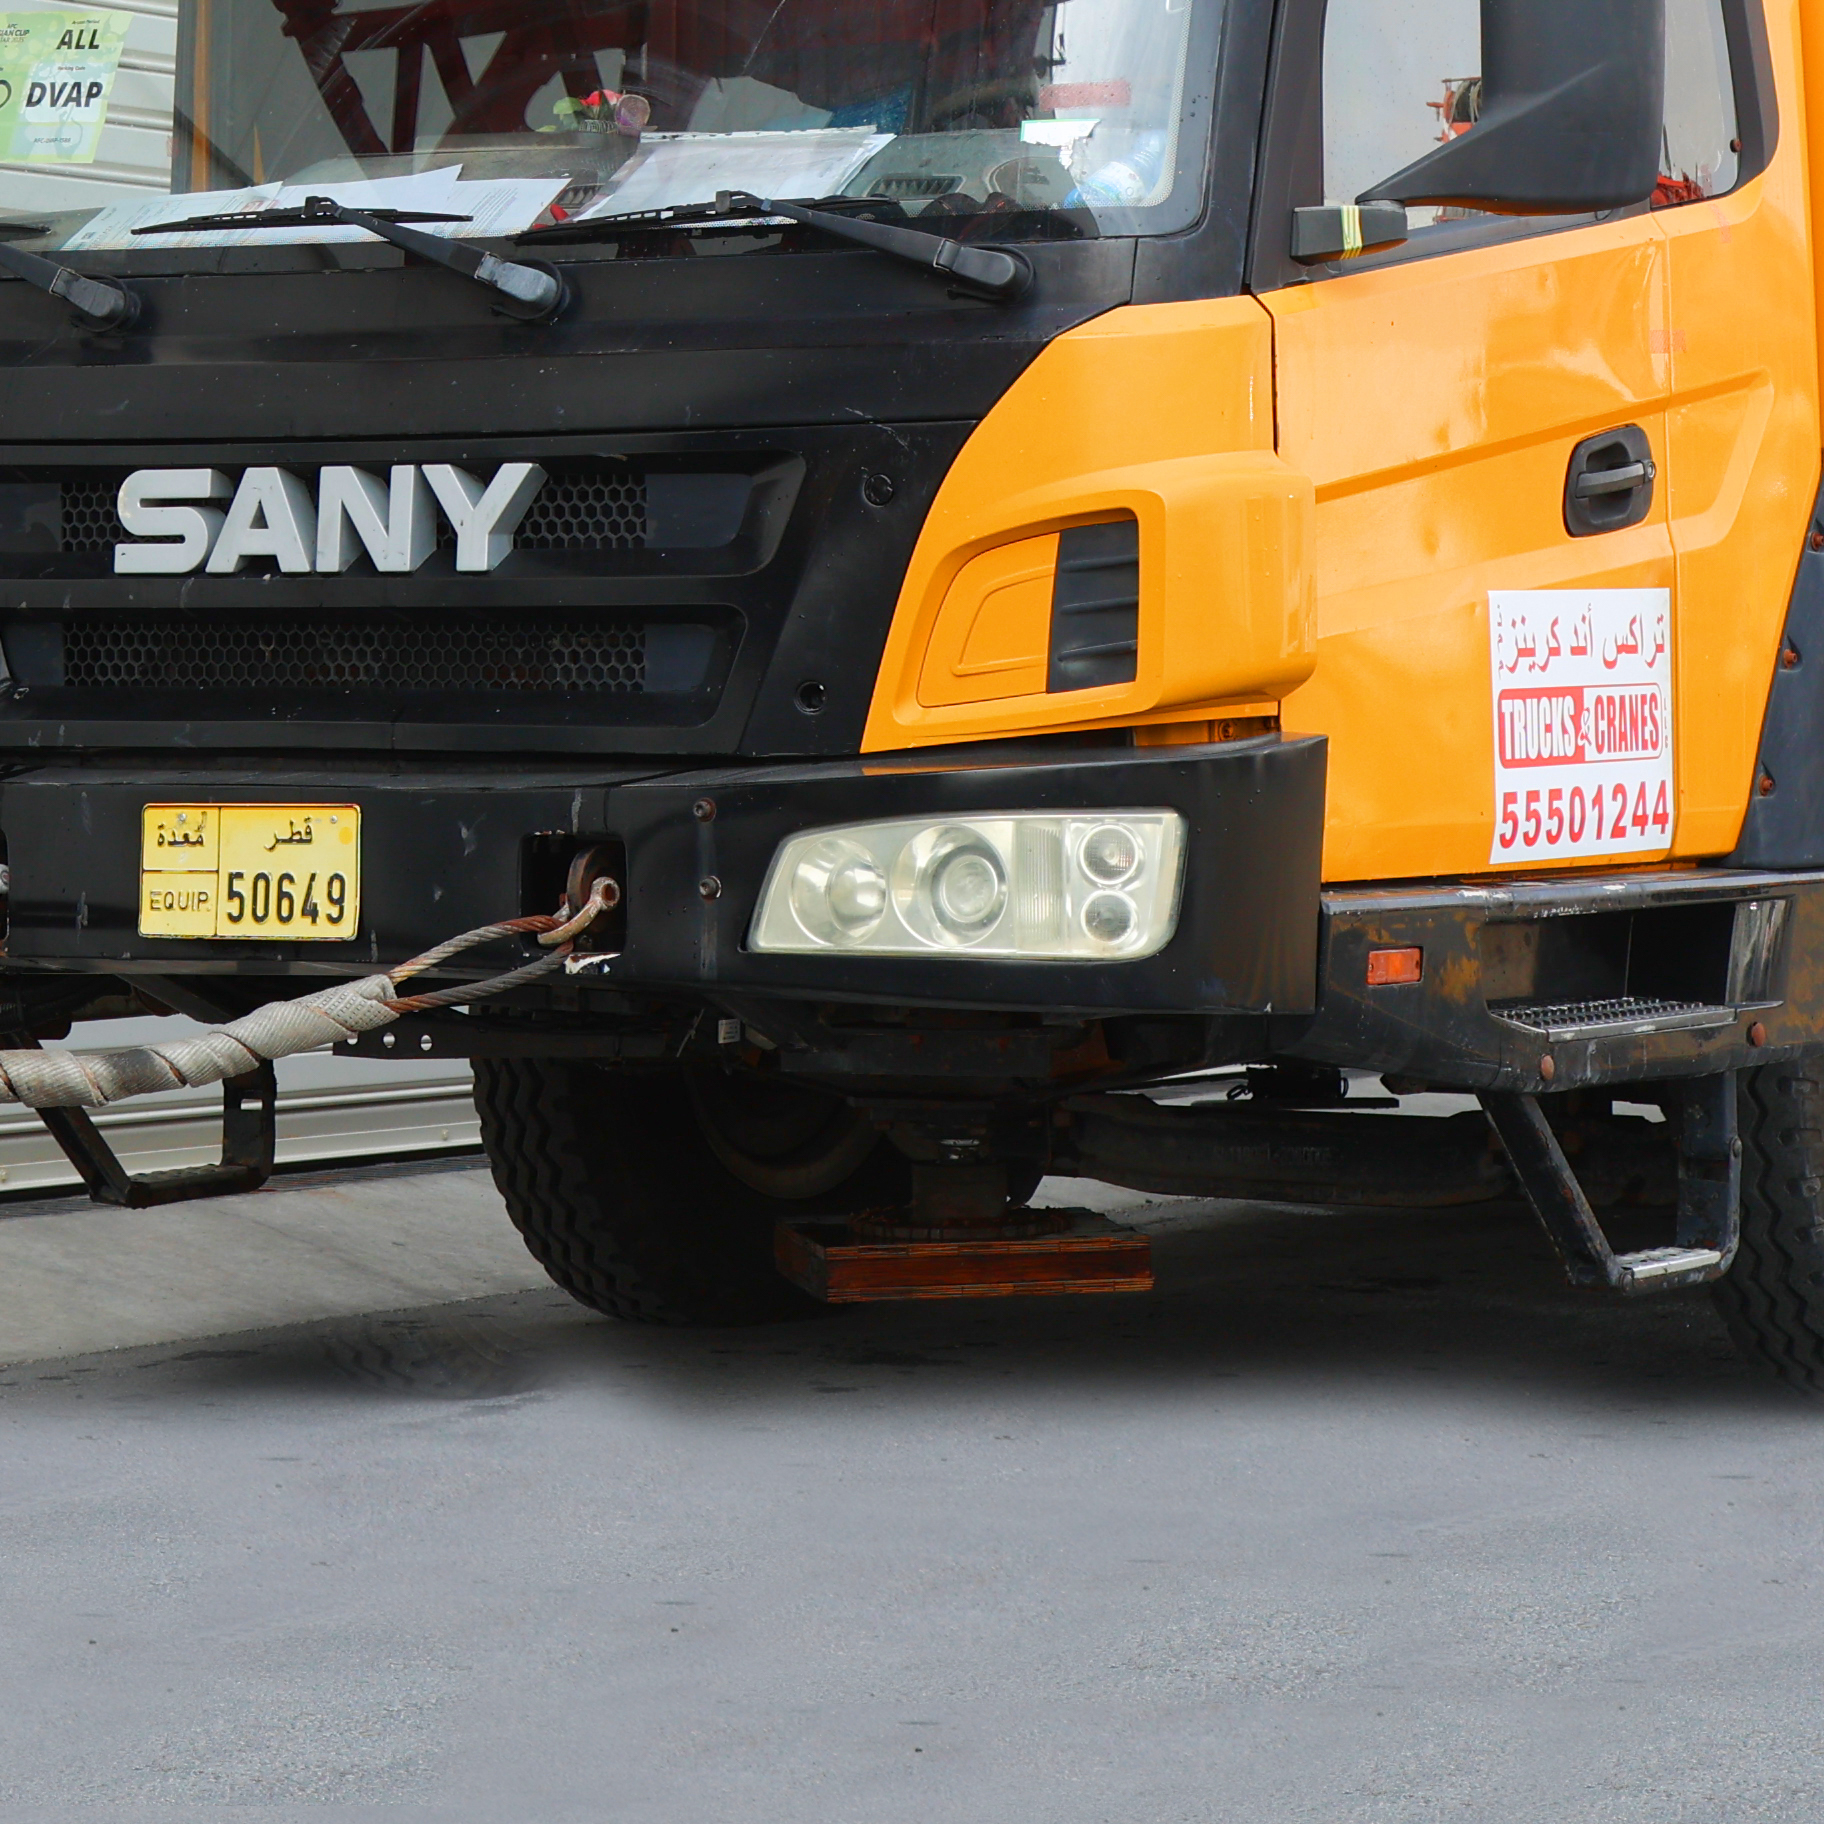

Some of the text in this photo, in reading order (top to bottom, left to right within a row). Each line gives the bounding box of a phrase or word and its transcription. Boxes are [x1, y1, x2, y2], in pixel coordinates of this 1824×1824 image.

[15, 29, 30, 37] CUP
[56, 29, 100, 50] ALL
[26, 81, 104, 108] DVAP
[114, 462, 549, 574] SANY
[1602, 612, 1666, 670] تراكس
[1502, 695, 1576, 761] TRUCKS
[1594, 692, 1659, 755] CRANES
[263, 816, 315, 851] قطر
[1499, 779, 1670, 849] 55501244
[226, 870, 348, 925] 50649
